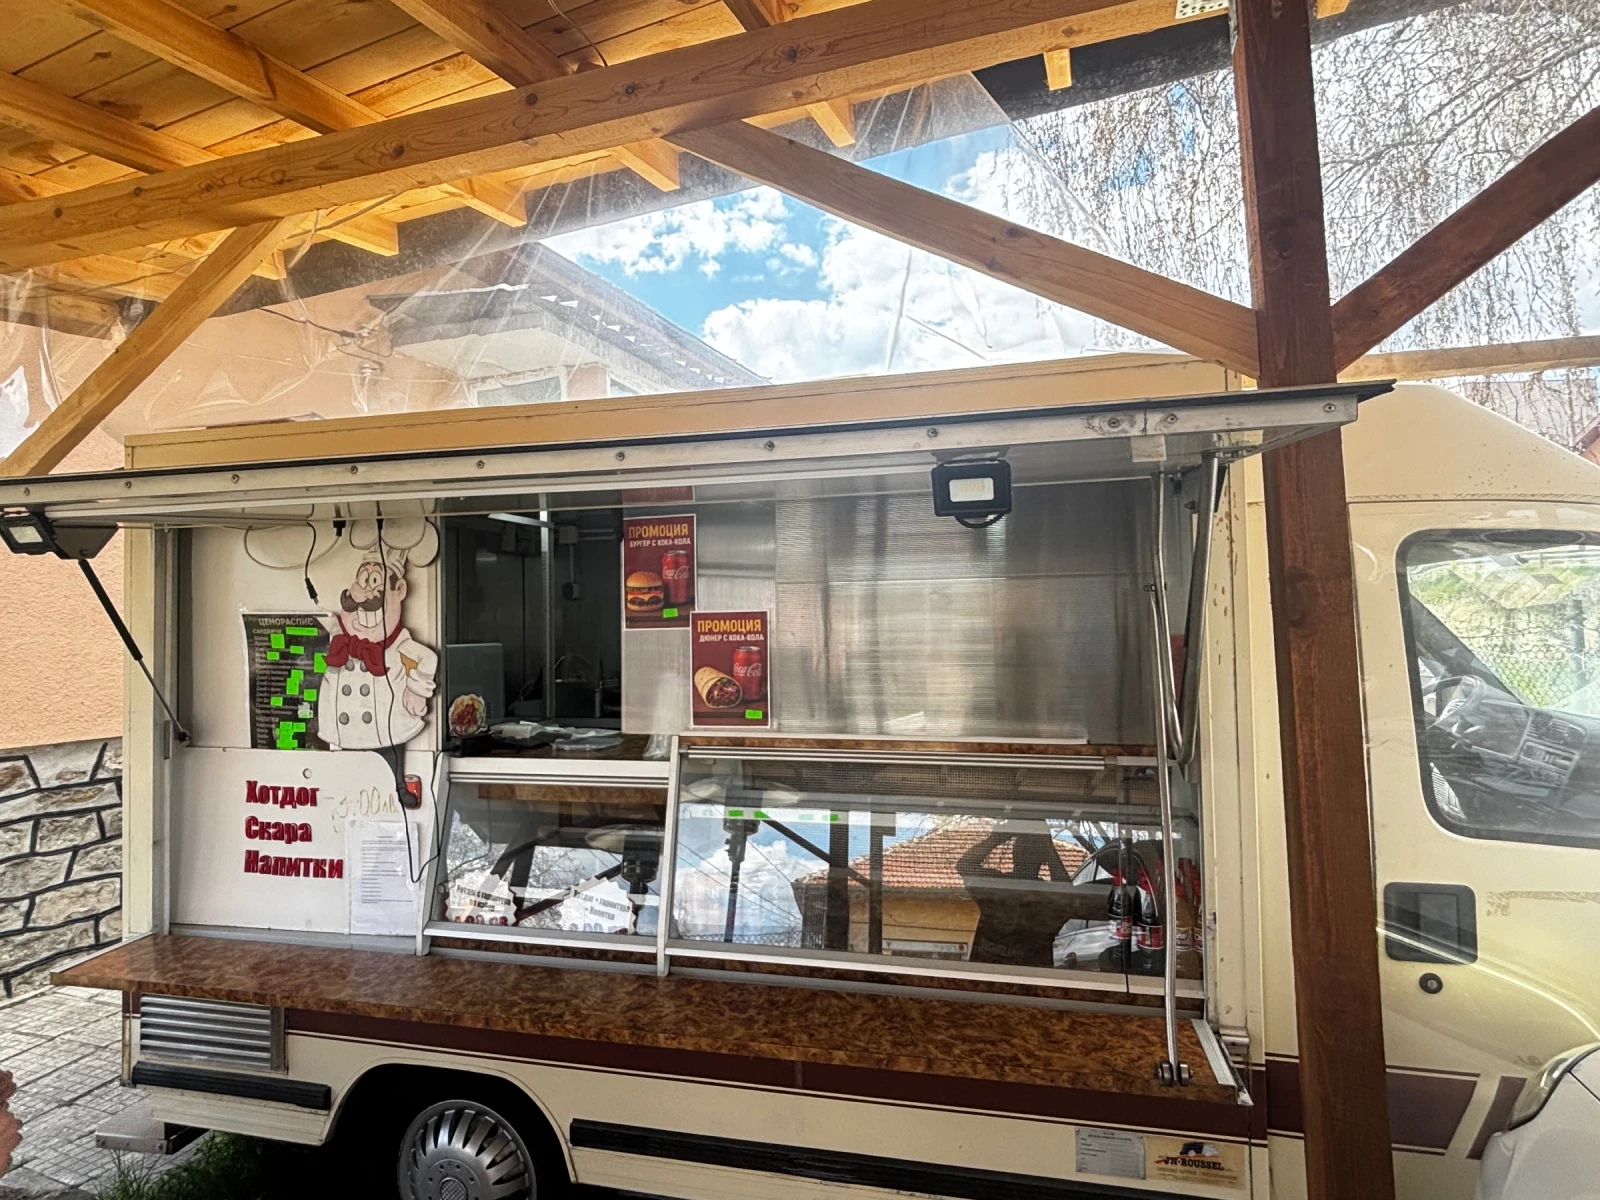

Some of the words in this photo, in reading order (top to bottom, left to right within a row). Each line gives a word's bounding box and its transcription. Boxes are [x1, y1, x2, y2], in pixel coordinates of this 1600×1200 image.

[628, 523, 689, 539] ПРОМОЦИЯ
[629, 539, 651, 548] БУРГЕР
[651, 539, 657, 547] С
[657, 537, 691, 546] КОКА-КОЛА
[258, 617, 314, 626] ЦЕНОРАСПИС
[697, 618, 762, 633] ПРОМОЦИЯ
[699, 634, 723, 642] ДЮНЕР
[729, 633, 764, 641] КОКА-КОЛА
[245, 780, 320, 808] Хотдог
[244, 815, 313, 844] Скара
[243, 849, 344, 879] Напитки
